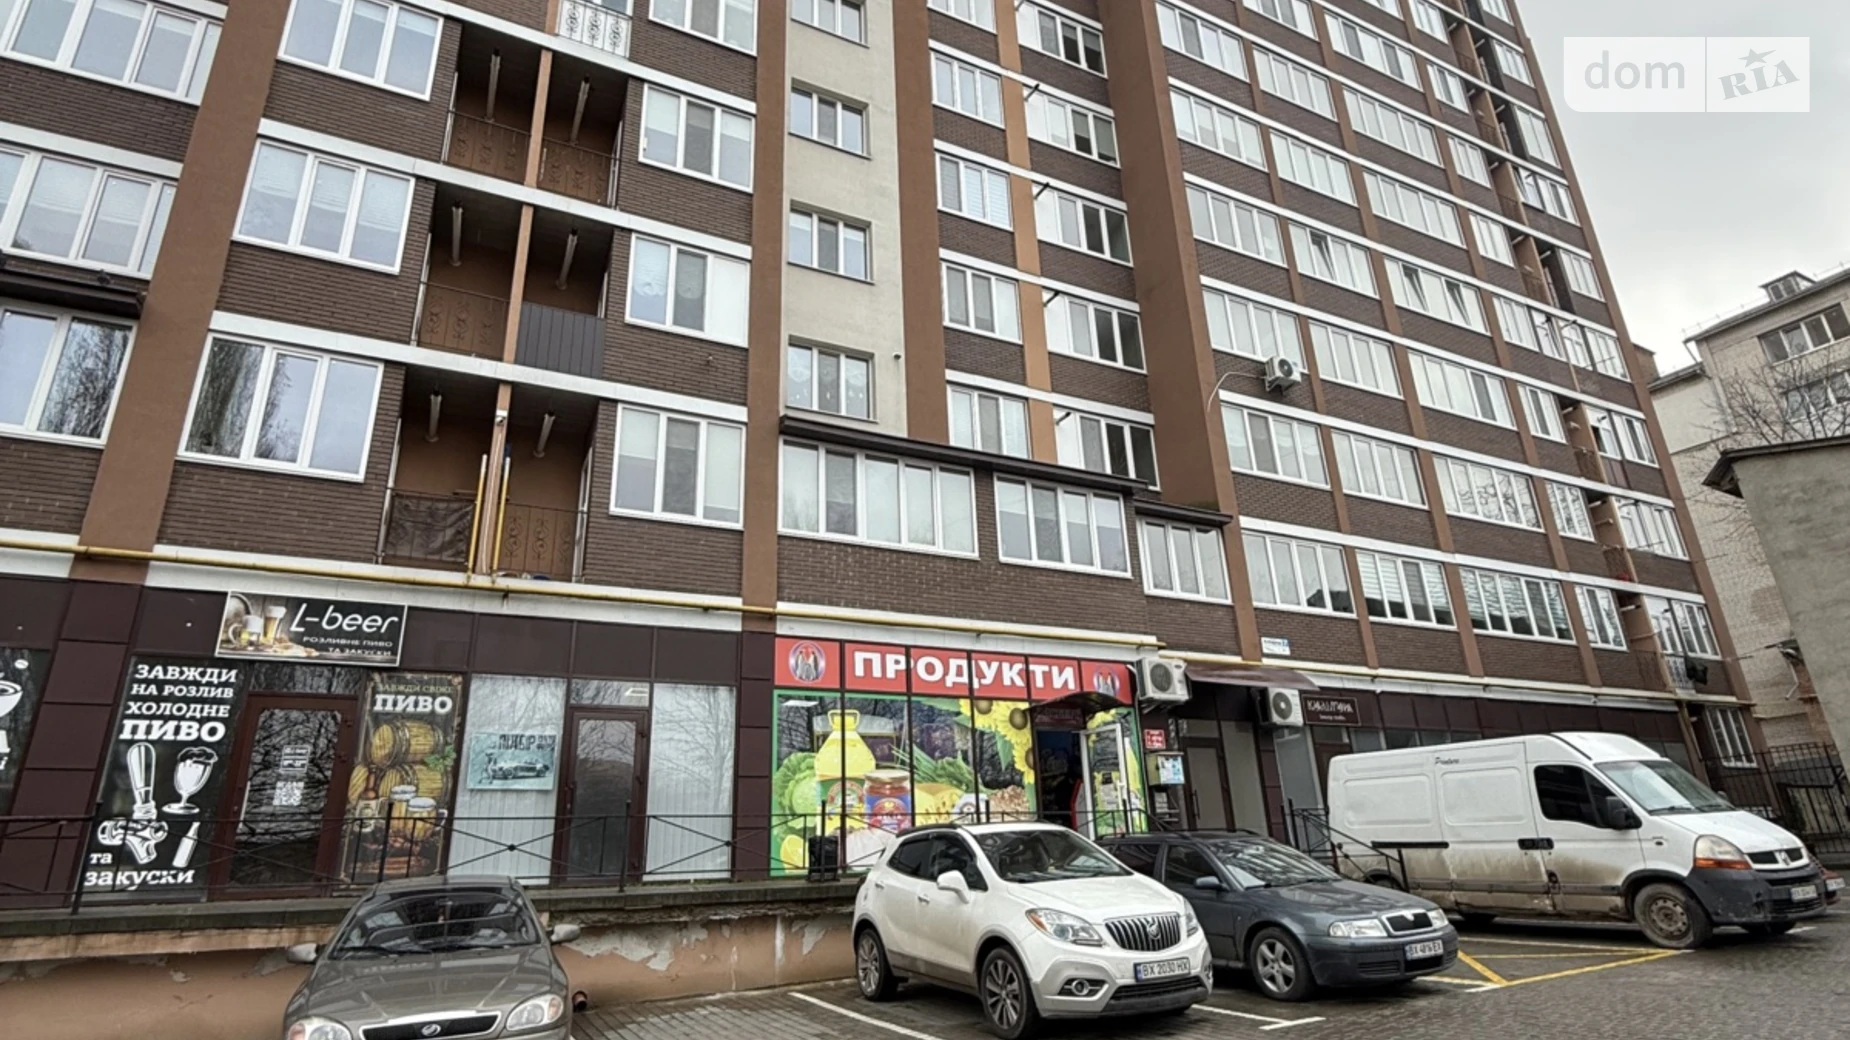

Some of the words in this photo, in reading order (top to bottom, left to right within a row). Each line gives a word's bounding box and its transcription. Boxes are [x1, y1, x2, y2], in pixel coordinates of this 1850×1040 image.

[289, 602, 399, 634] L-beer
[362, 640, 393, 648] ПИВО
[134, 664, 238, 684] ЗАВЖДИ
[853, 650, 1076, 690] ПРОДУКТИ
[130, 683, 158, 695] НА
[162, 684, 234, 698] РОЗЛИВ
[124, 701, 231, 719] ХОЛОДНЕ
[373, 693, 453, 715] ПИВО
[118, 719, 226, 742] ПИВО
[89, 852, 113, 864] та
[83, 869, 195, 891] закуски
